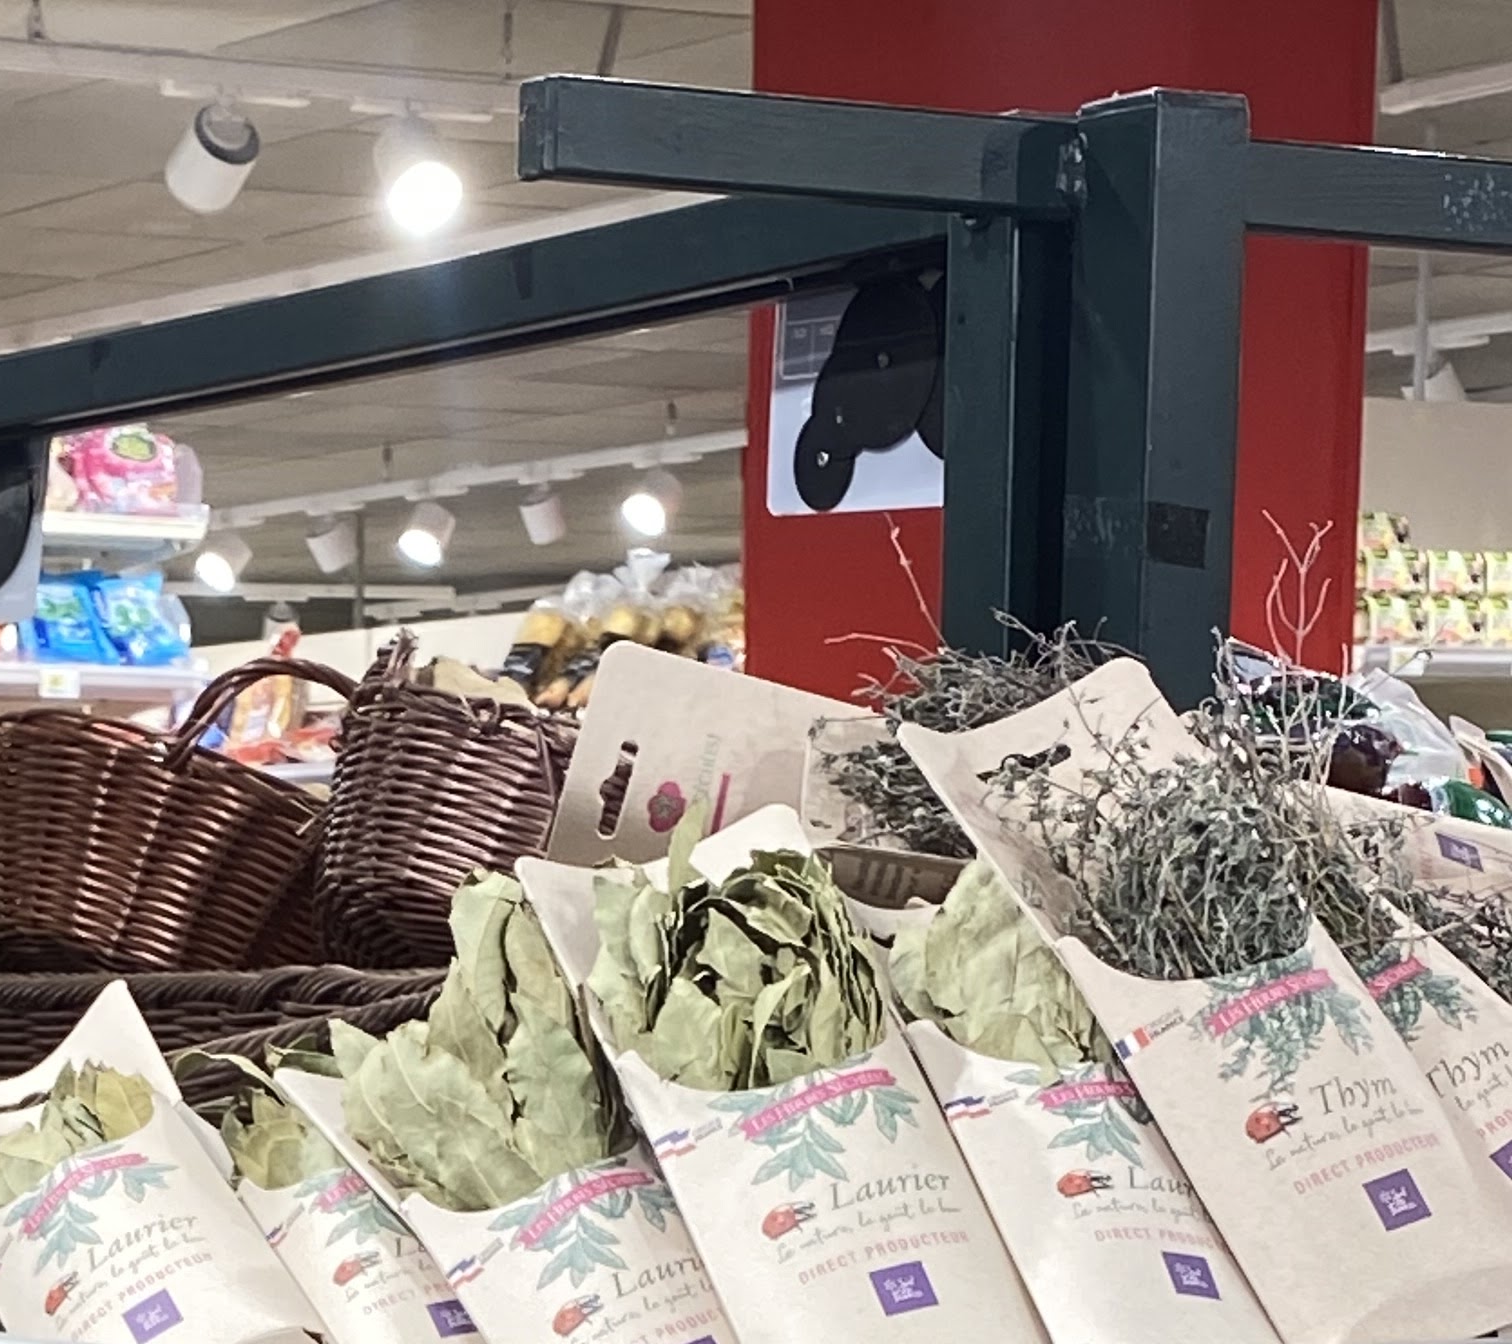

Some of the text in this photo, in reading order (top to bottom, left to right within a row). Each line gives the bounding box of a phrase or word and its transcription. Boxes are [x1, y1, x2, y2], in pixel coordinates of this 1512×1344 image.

[1309, 1076, 1398, 1116] Thym
[829, 1164, 951, 1212] Laurier
[1293, 1159, 1352, 1195] DIRECT
[87, 1213, 199, 1274] Laurier
[798, 1230, 970, 1286] DIRECT PRODUCTEUR
